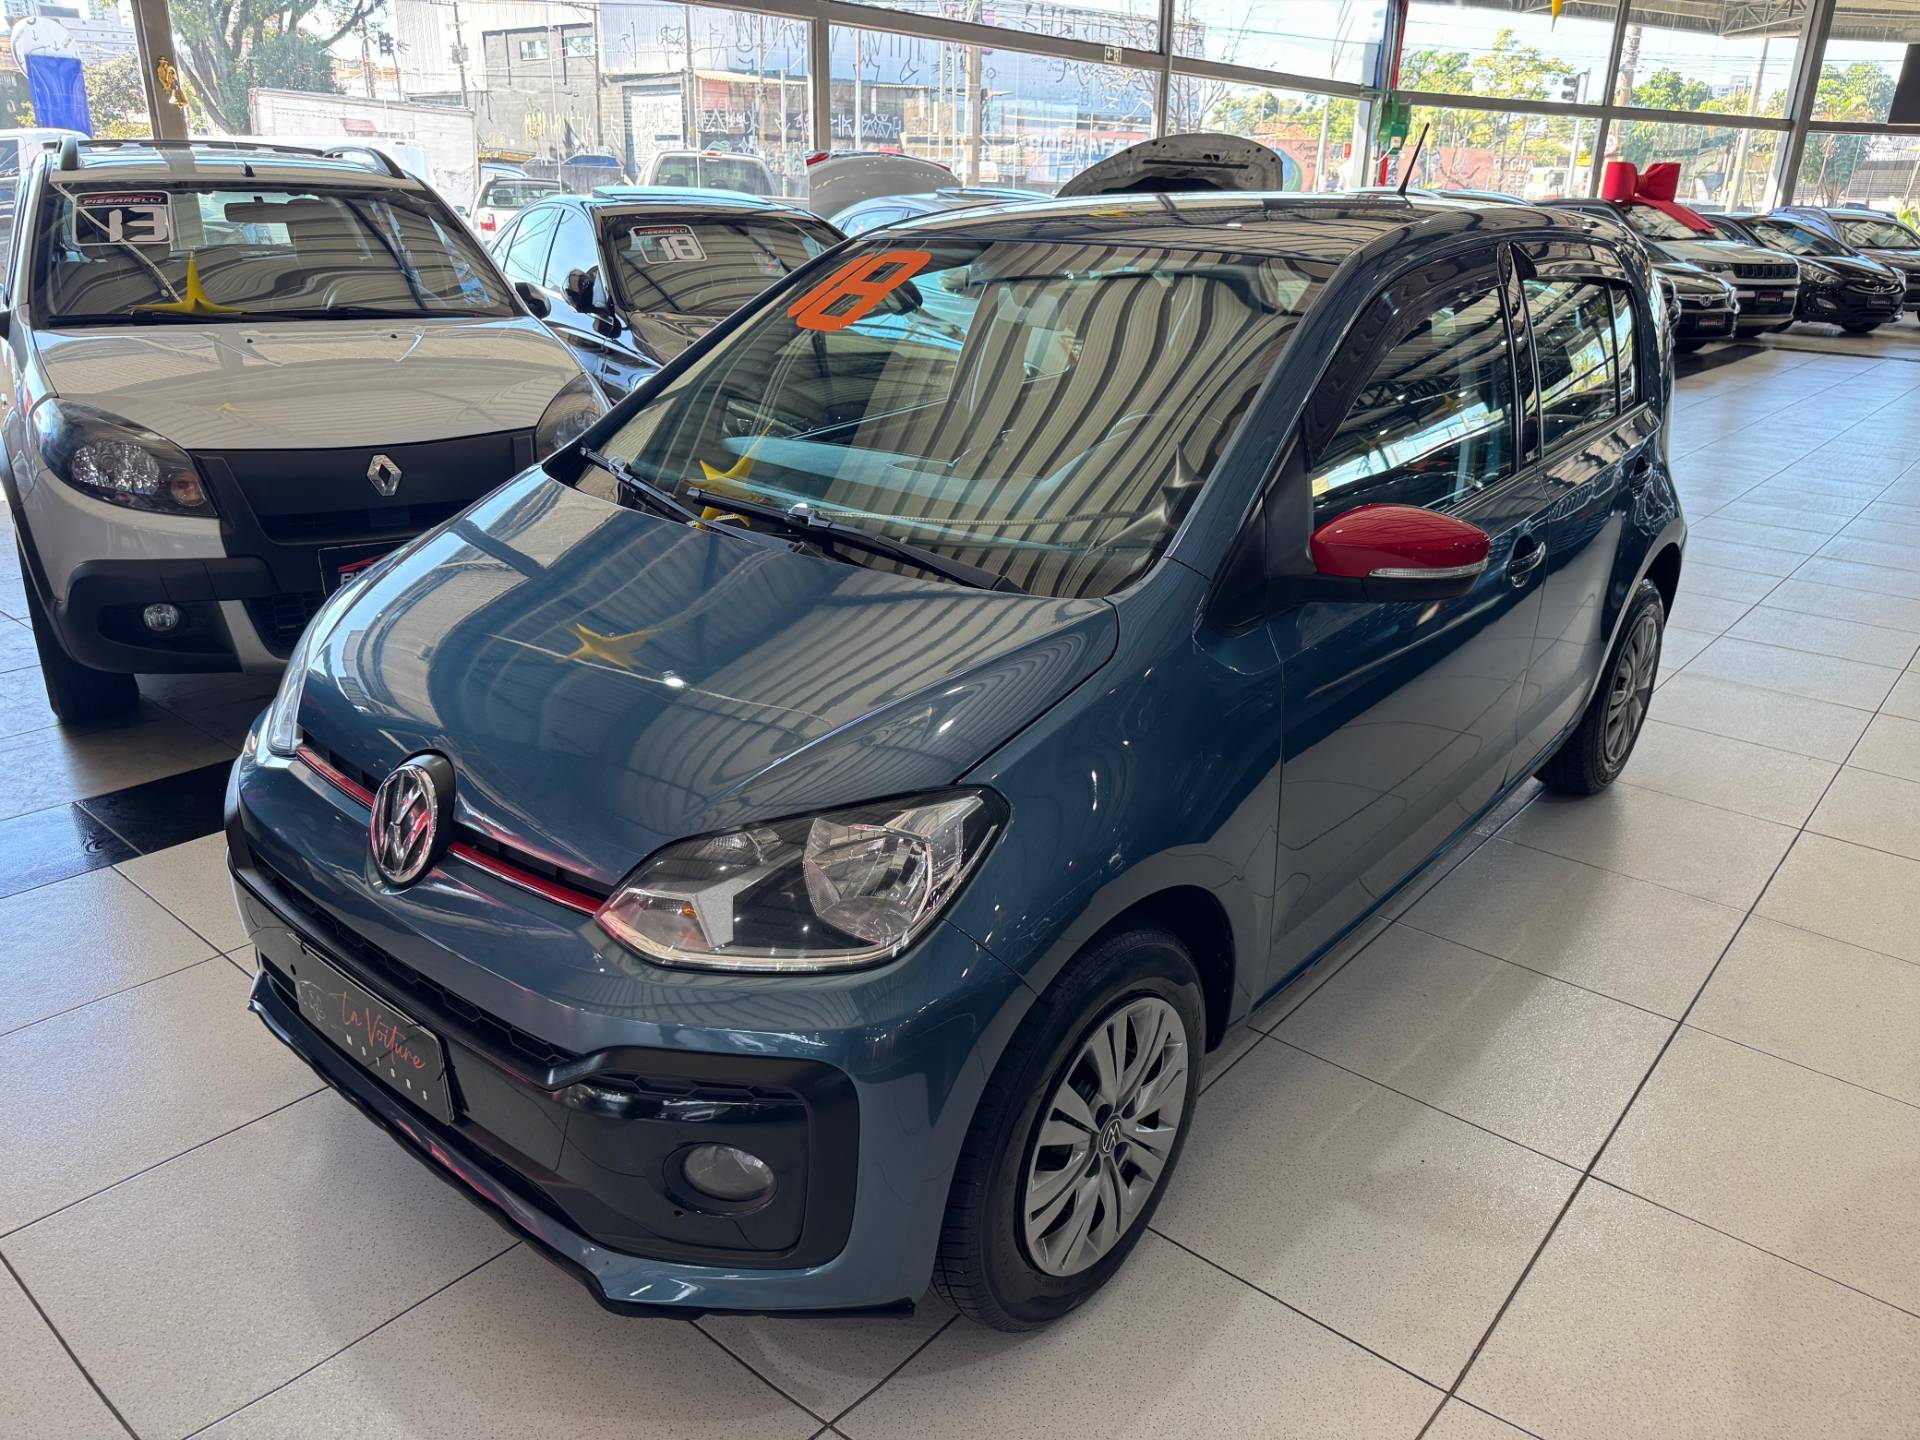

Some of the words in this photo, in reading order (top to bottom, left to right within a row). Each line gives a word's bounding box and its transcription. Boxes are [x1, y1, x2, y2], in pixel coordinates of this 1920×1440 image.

[83, 197, 162, 205] PISSARELLI
[108, 206, 168, 242] 13
[659, 235, 703, 261] 18
[787, 250, 932, 332] 18
[365, 1007, 427, 1070] Voiture
